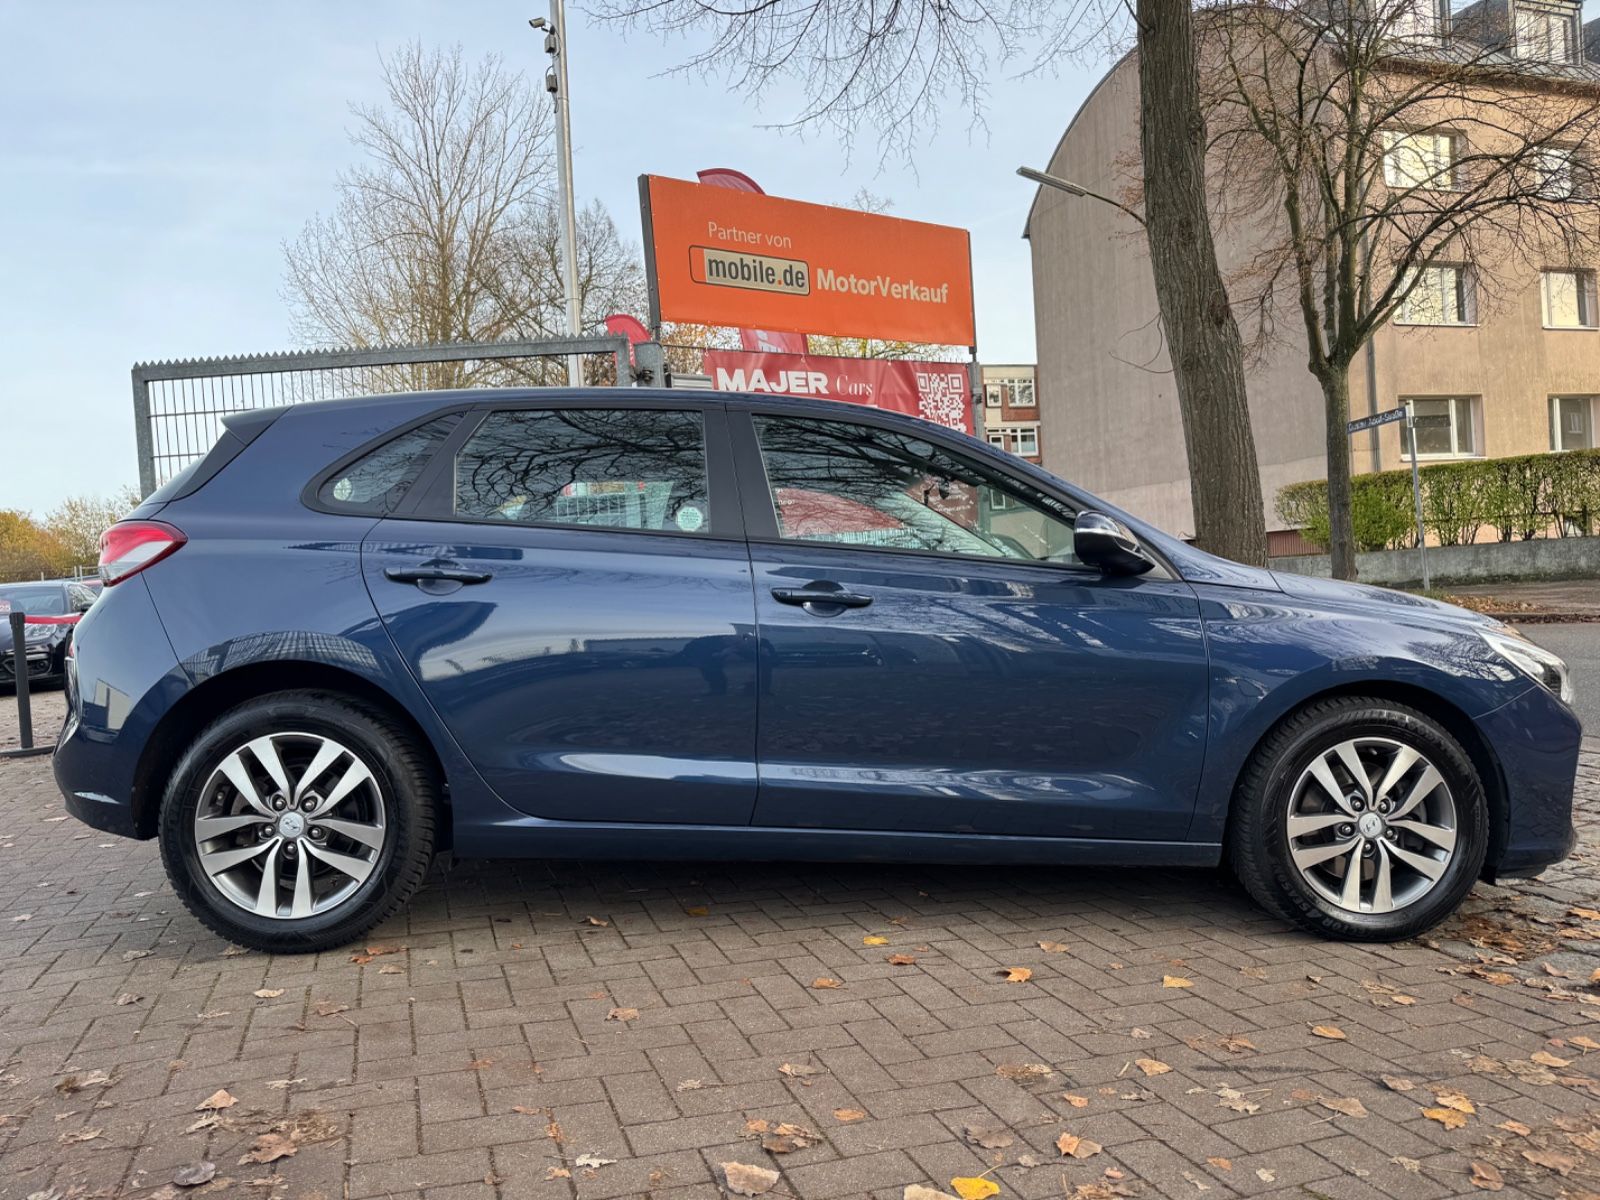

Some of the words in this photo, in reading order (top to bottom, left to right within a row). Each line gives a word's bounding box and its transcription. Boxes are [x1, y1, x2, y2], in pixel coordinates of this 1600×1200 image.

[707, 221, 762, 244] Partner
[765, 233, 792, 248] von
[707, 257, 806, 288] mobile.de
[816, 267, 949, 303] MotorVerkauf
[716, 367, 829, 394] MAJER
[836, 373, 873, 396] Cars
